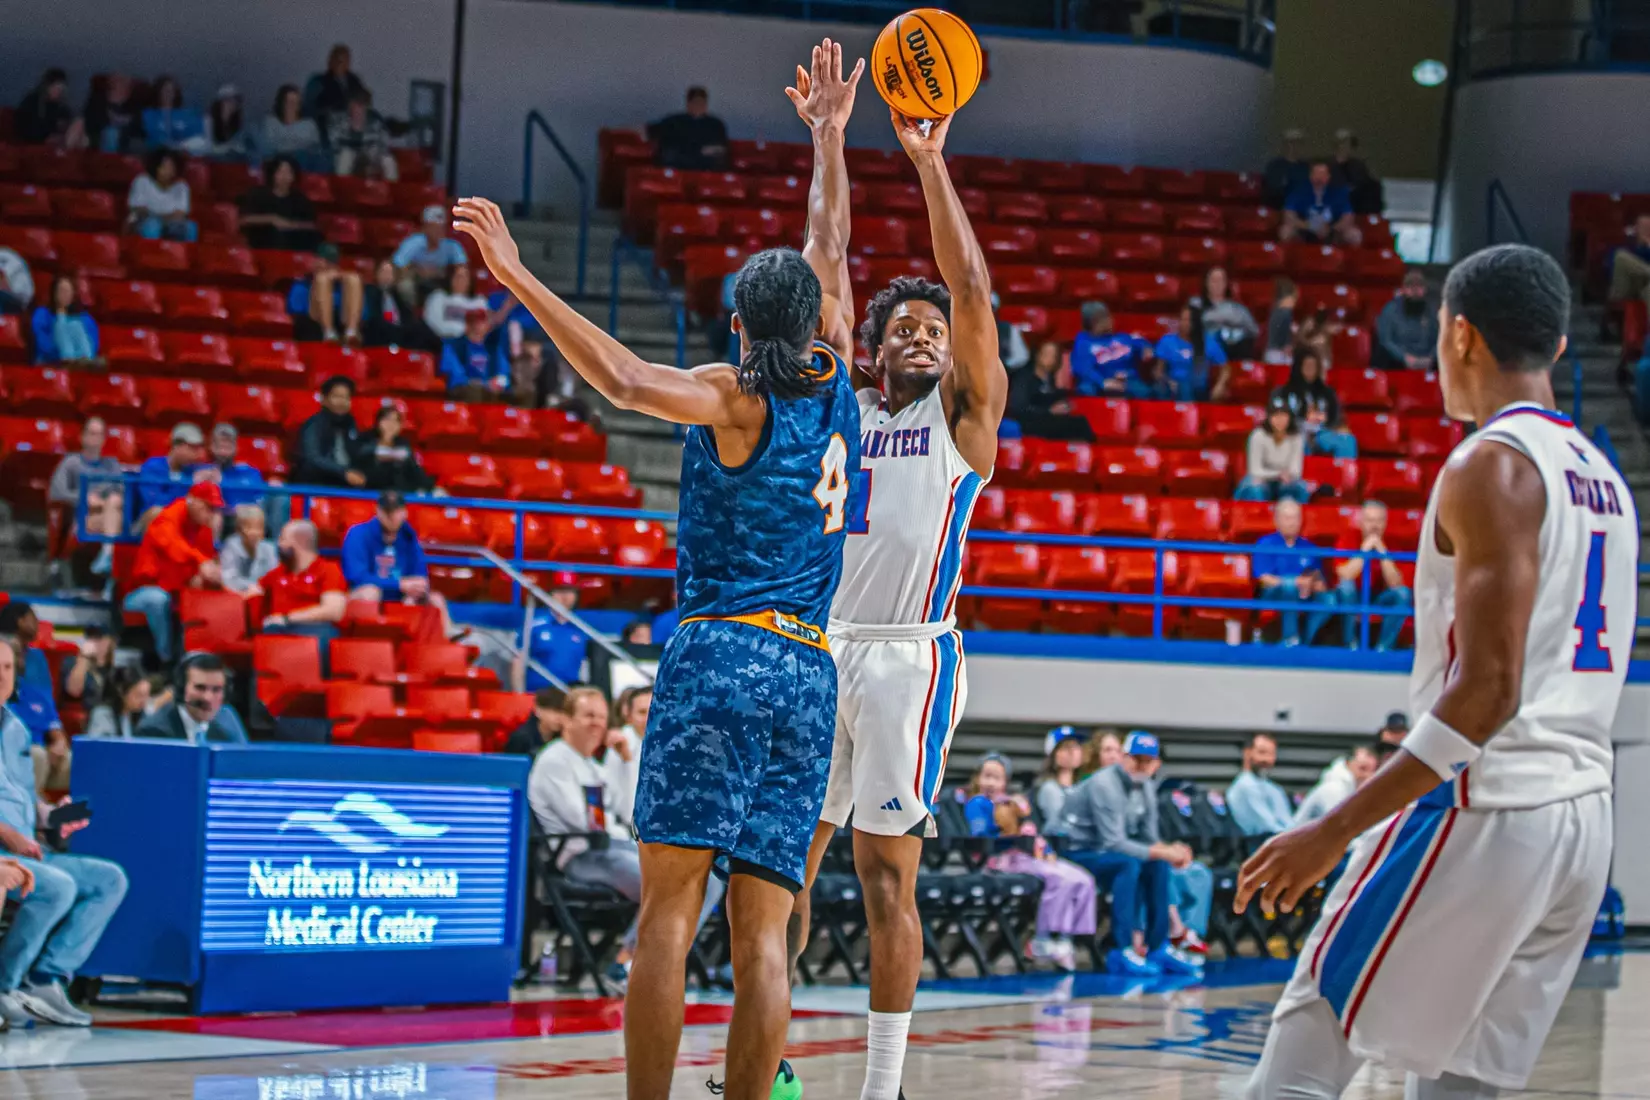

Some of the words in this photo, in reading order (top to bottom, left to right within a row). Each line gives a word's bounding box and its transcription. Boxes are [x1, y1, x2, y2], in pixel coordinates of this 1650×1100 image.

[906, 27, 944, 102] Wilson
[891, 426, 931, 458] TECH
[811, 432, 849, 535] 4
[248, 855, 354, 898] Northern
[357, 855, 460, 898] Louisiana
[264, 904, 359, 946] Medical
[361, 904, 440, 945] Center
